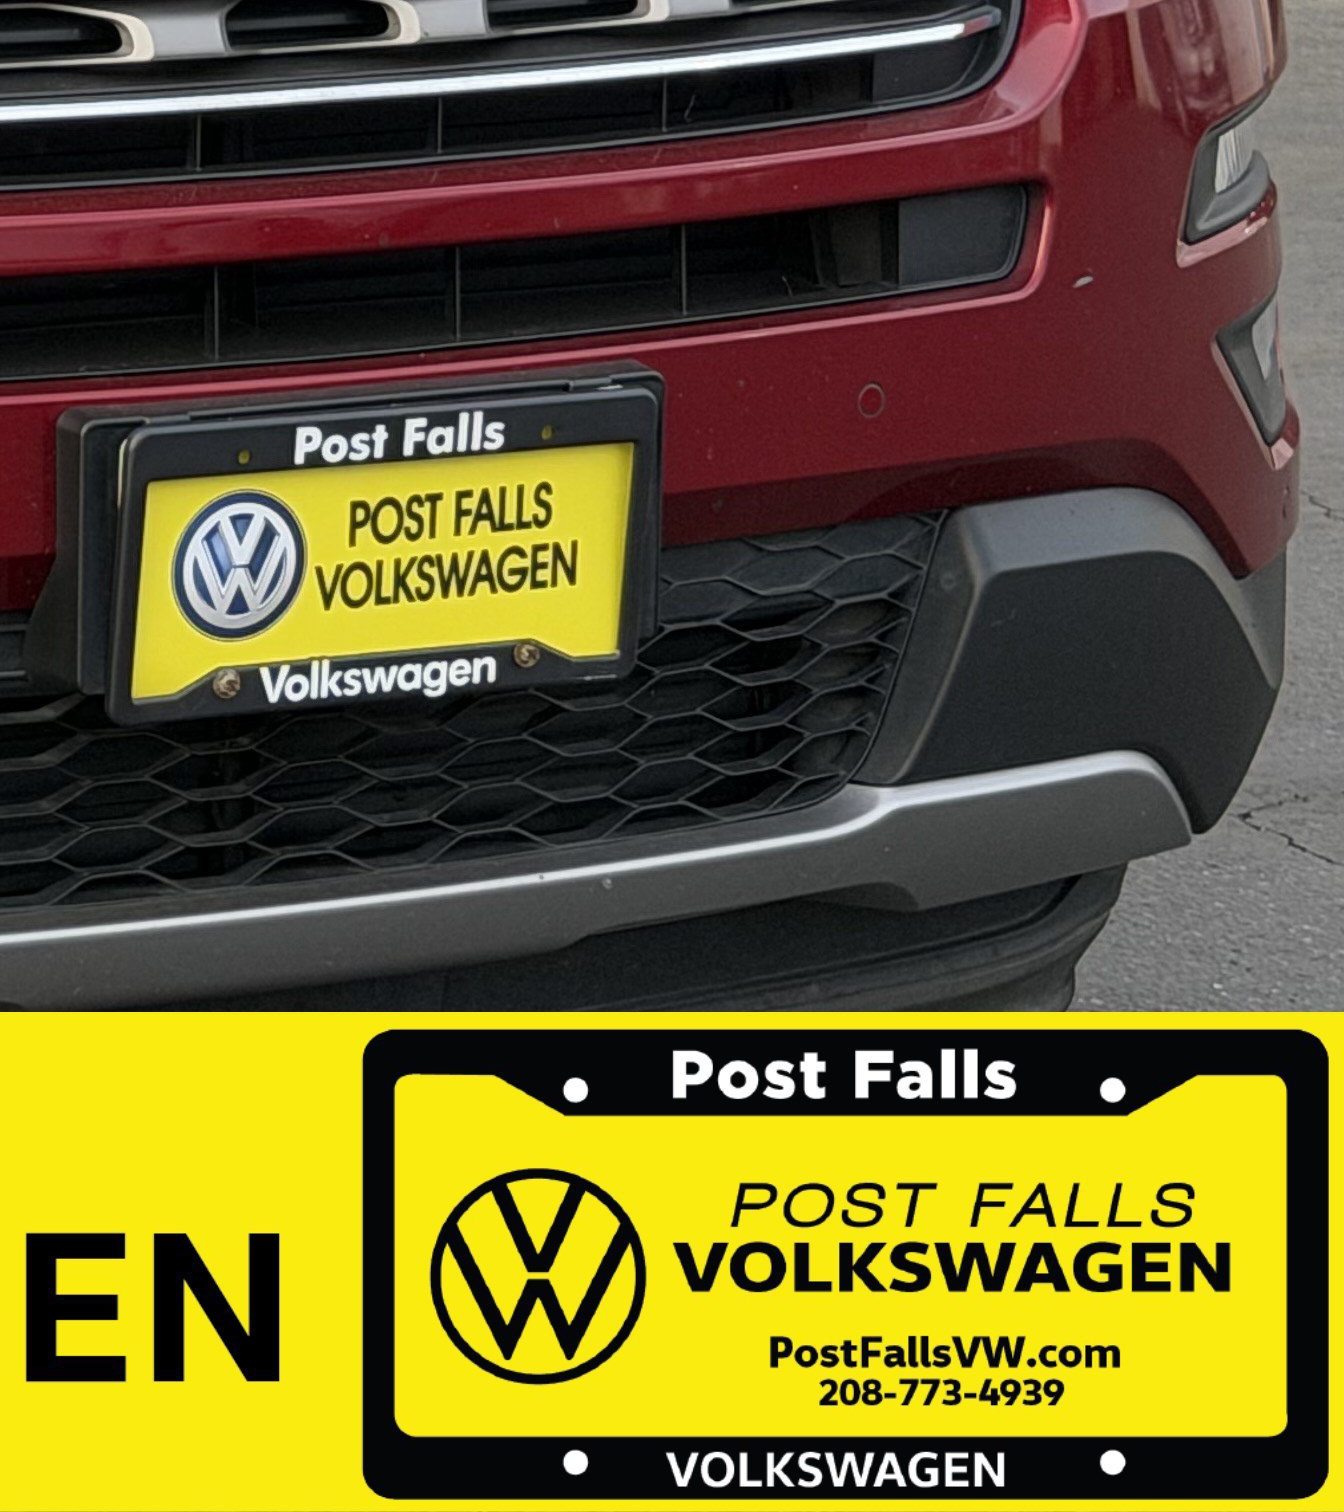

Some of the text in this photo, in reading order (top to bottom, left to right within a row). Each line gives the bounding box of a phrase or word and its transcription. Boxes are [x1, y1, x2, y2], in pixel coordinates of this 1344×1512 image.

[293, 411, 506, 465] Post Falls
[348, 482, 554, 547] POST FALLS
[315, 539, 578, 611] VOLKSWAGEN
[260, 655, 497, 704] Volkswagen
